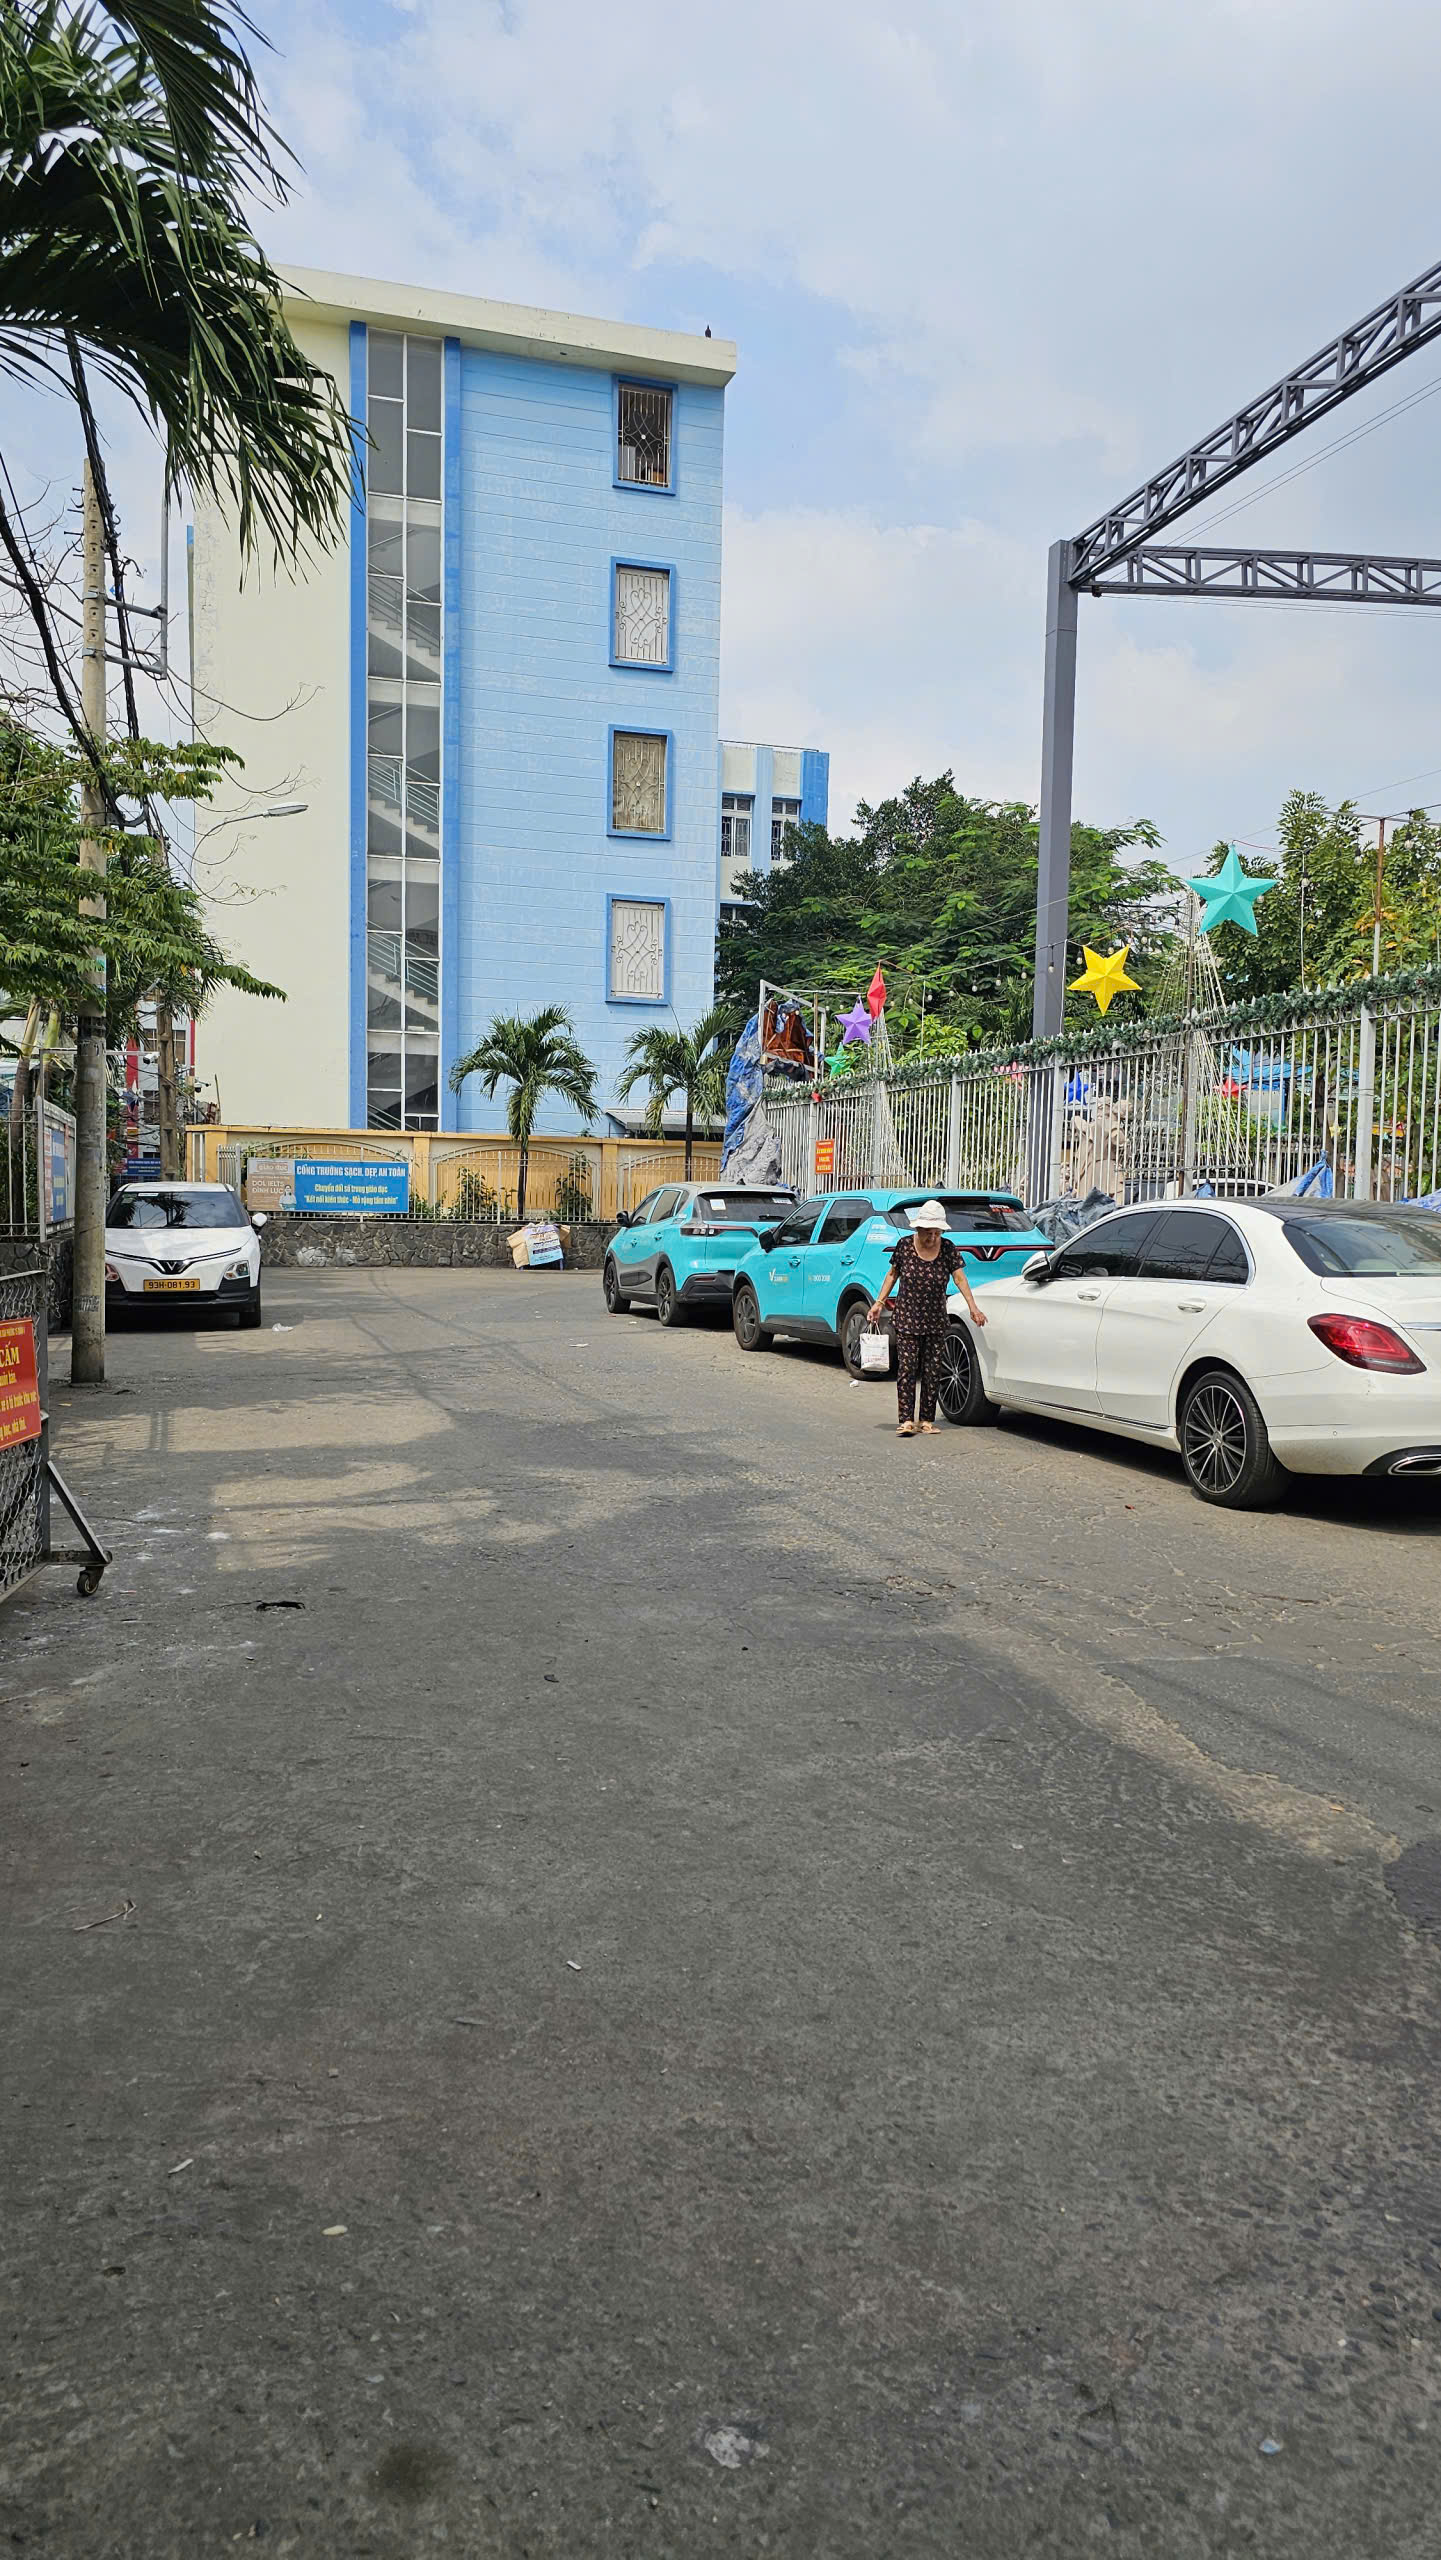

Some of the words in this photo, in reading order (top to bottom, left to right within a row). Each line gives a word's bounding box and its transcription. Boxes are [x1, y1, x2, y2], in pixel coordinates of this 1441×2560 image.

[297, 1164, 315, 1176] CỔNG
[316, 1165, 343, 1176] TRƯỜNG
[379, 1168, 387, 1176] AN
[388, 1166, 405, 1177] TOÀN
[149, 1281, 195, 1289] 93H-081.93
